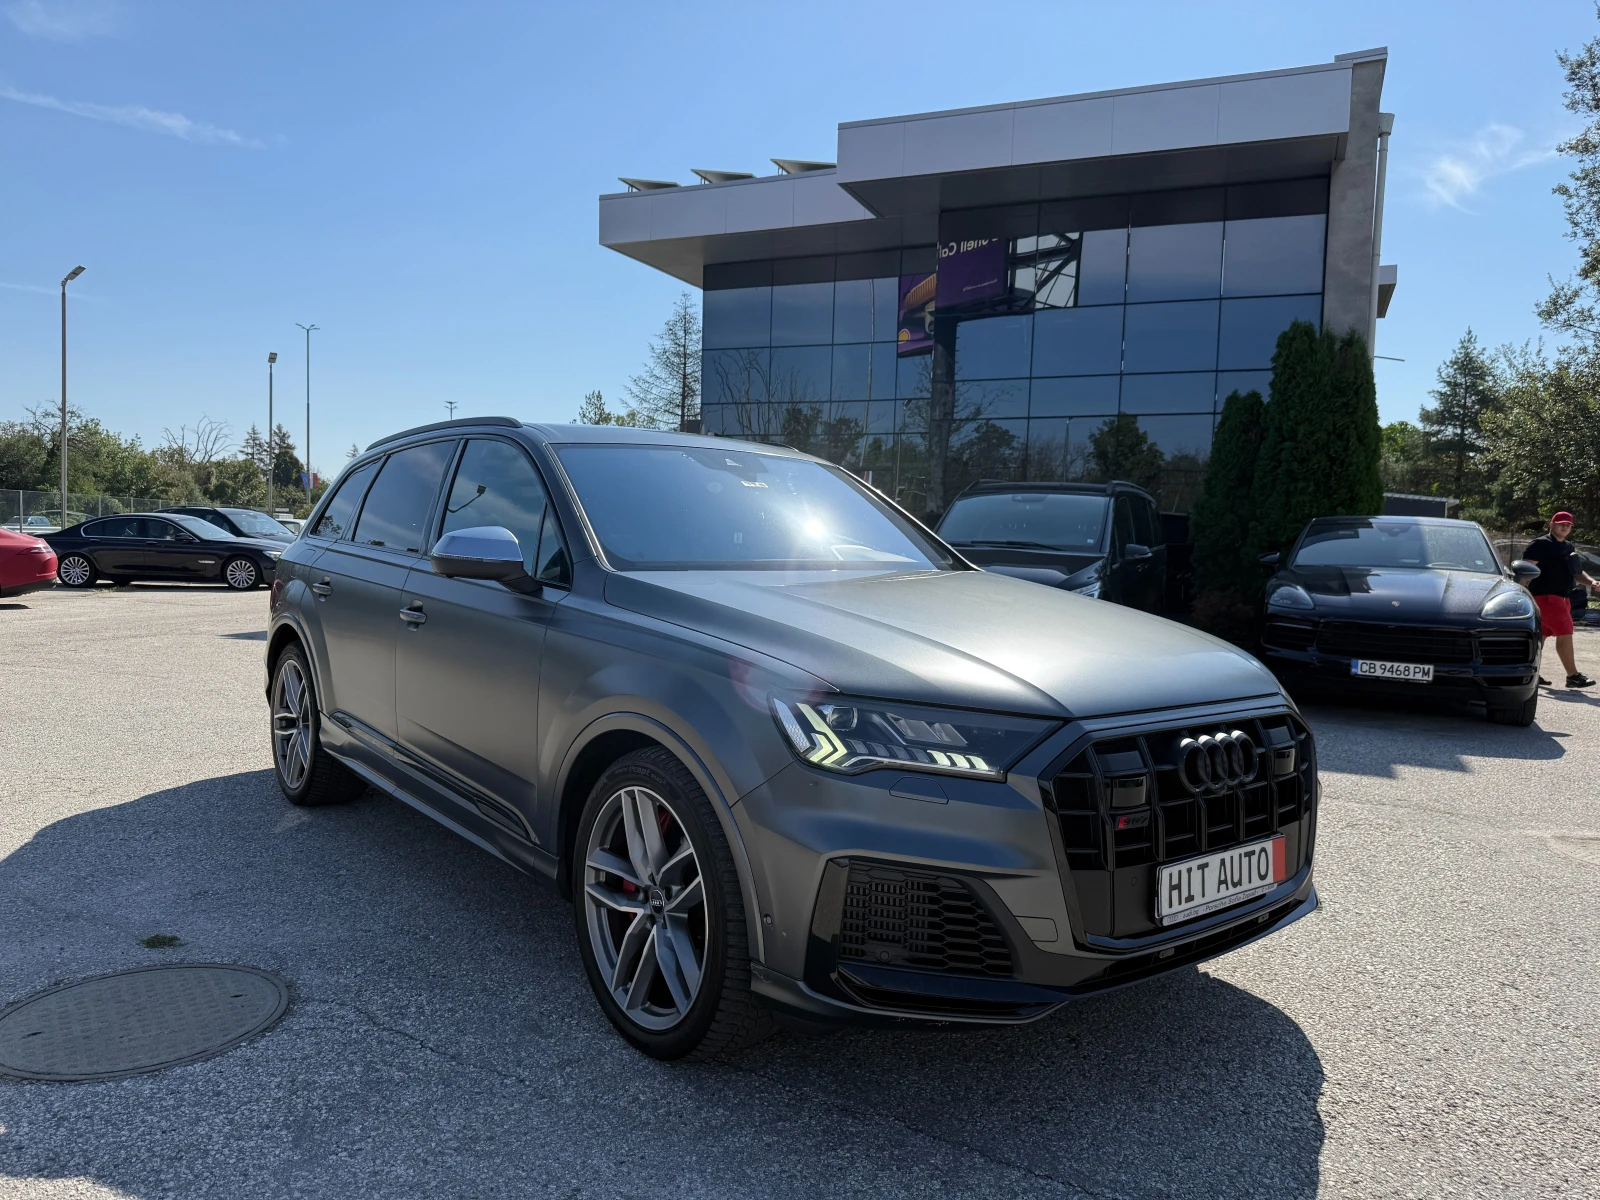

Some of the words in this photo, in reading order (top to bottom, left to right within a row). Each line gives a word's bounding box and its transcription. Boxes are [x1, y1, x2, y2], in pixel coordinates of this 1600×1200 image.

[1360, 662, 1376, 674] CB
[1379, 664, 1410, 677] 9468
[1413, 666, 1431, 678] PM
[1168, 862, 1209, 908] HIT
[1217, 847, 1269, 893] AUTO
[1205, 900, 1227, 912] Porsche
